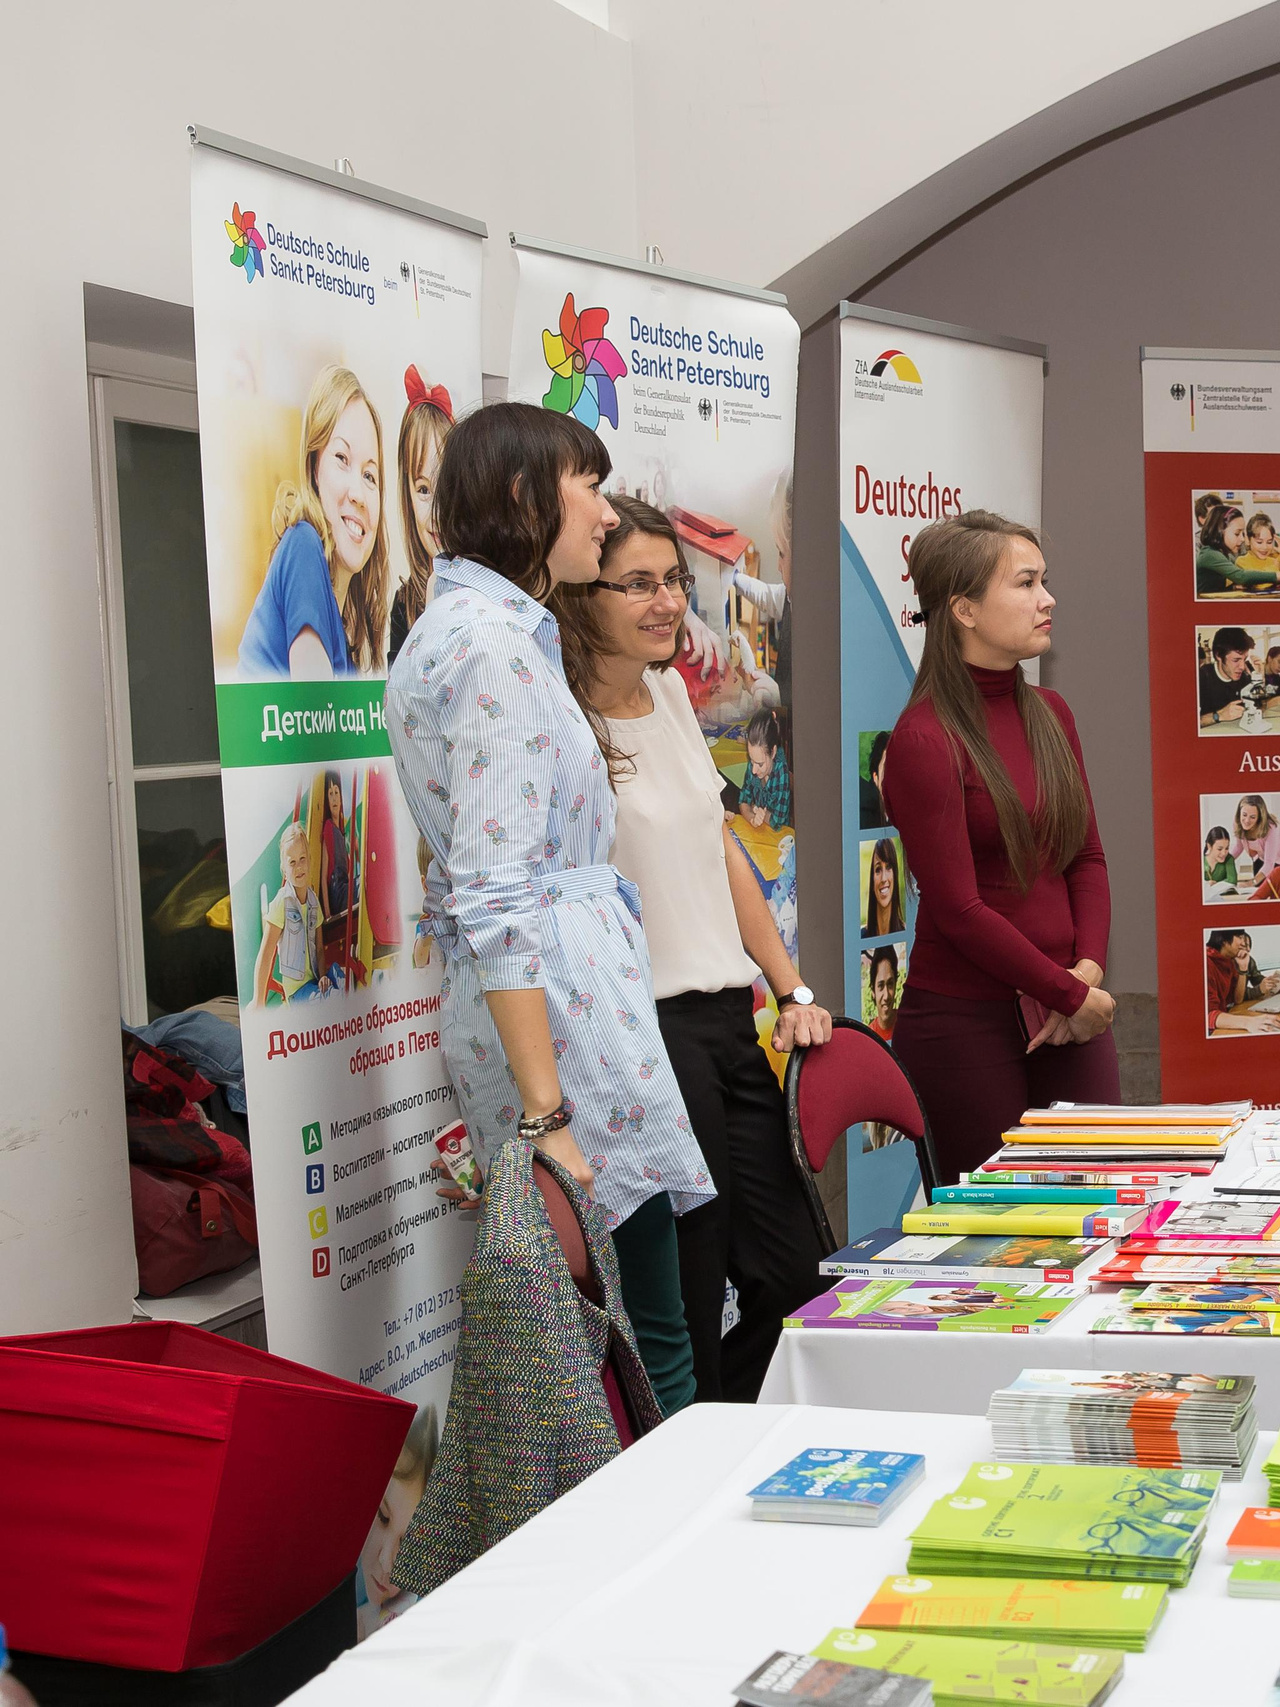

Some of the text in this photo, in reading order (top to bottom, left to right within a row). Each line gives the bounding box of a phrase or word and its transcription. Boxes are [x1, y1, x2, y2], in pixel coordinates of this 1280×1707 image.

[266, 222, 370, 272] Deutsche Schule
[270, 252, 375, 305] Sankt Petersburg
[383, 275, 398, 291] beim
[629, 315, 764, 361] Deutsche Schule
[631, 349, 770, 398] Sankt Petersburg
[854, 358, 869, 376] ZfA
[633, 383, 691, 404] beim Generalkonsulat
[854, 376, 924, 397] Deutsche Auslandsschularbeit
[854, 388, 885, 402] International
[1197, 384, 1273, 395] Bundesverwaltungsamt
[1202, 394, 1263, 404] Zentralstelle für das
[1203, 403, 1267, 412] Auslandsschulwesen
[633, 403, 685, 422] der Bundesrepublik
[634, 422, 667, 437] Deutschland
[855, 464, 962, 520] Deutsches
[261, 702, 337, 743] Детский
[339, 703, 366, 735] сад
[267, 1013, 364, 1061] Дошкольное
[349, 1041, 395, 1077] образца
[397, 1037, 406, 1058] в
[330, 1112, 372, 1140] Методика
[373, 1092, 423, 1122] «языкового
[308, 1127, 319, 1150] A
[333, 1148, 385, 1183] Воспитатели
[392, 1129, 435, 1157] носители
[311, 1168, 321, 1190] B
[336, 1192, 383, 1225] Маленькие
[383, 1177, 418, 1204] группы,
[312, 1211, 323, 1233] C
[338, 1230, 387, 1266] Подготовка
[387, 1226, 394, 1240] к
[394, 1206, 440, 1238] обучению
[441, 1203, 448, 1216] в
[316, 1251, 327, 1273] D
[340, 1241, 416, 1292] Санкт-Петербурга
[383, 1315, 401, 1338] Тел.:
[403, 1306, 414, 1326] +7
[414, 1295, 437, 1323] (812)
[437, 1288, 454, 1310] 372
[1206, 1302, 1231, 1310] MARKET
[1232, 1302, 1256, 1310] CAMDEN
[358, 1358, 386, 1386] Адрес:
[387, 1344, 405, 1367] В.О.,
[405, 1338, 418, 1361] ул.
[993, 1528, 1015, 1538] C1
